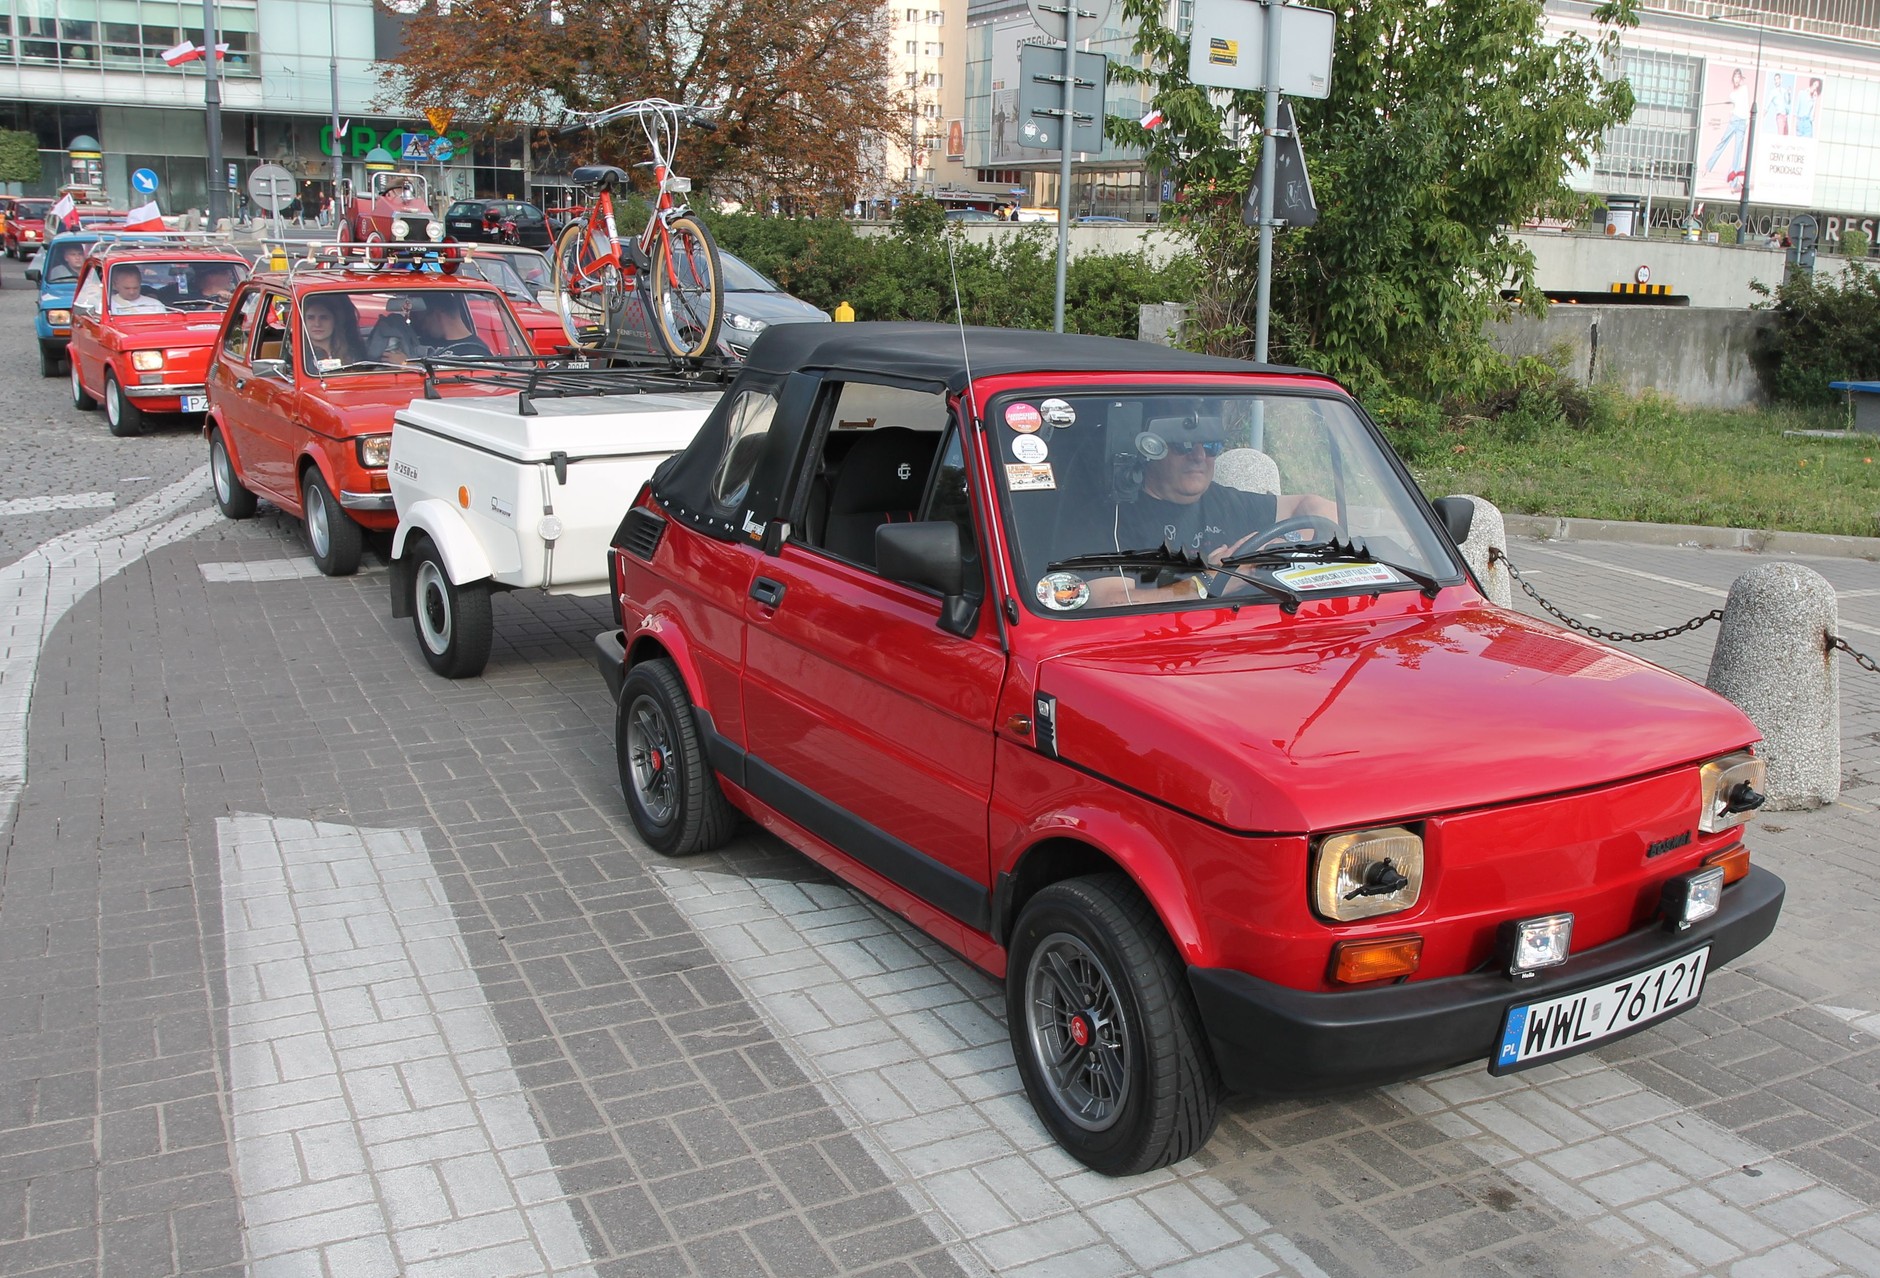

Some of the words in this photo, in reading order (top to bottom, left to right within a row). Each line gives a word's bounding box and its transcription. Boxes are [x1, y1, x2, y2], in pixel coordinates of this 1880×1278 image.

[1524, 996, 1592, 1056] WWL
[1606, 955, 1702, 1031] 76121
[1501, 1043, 1518, 1058] PL
